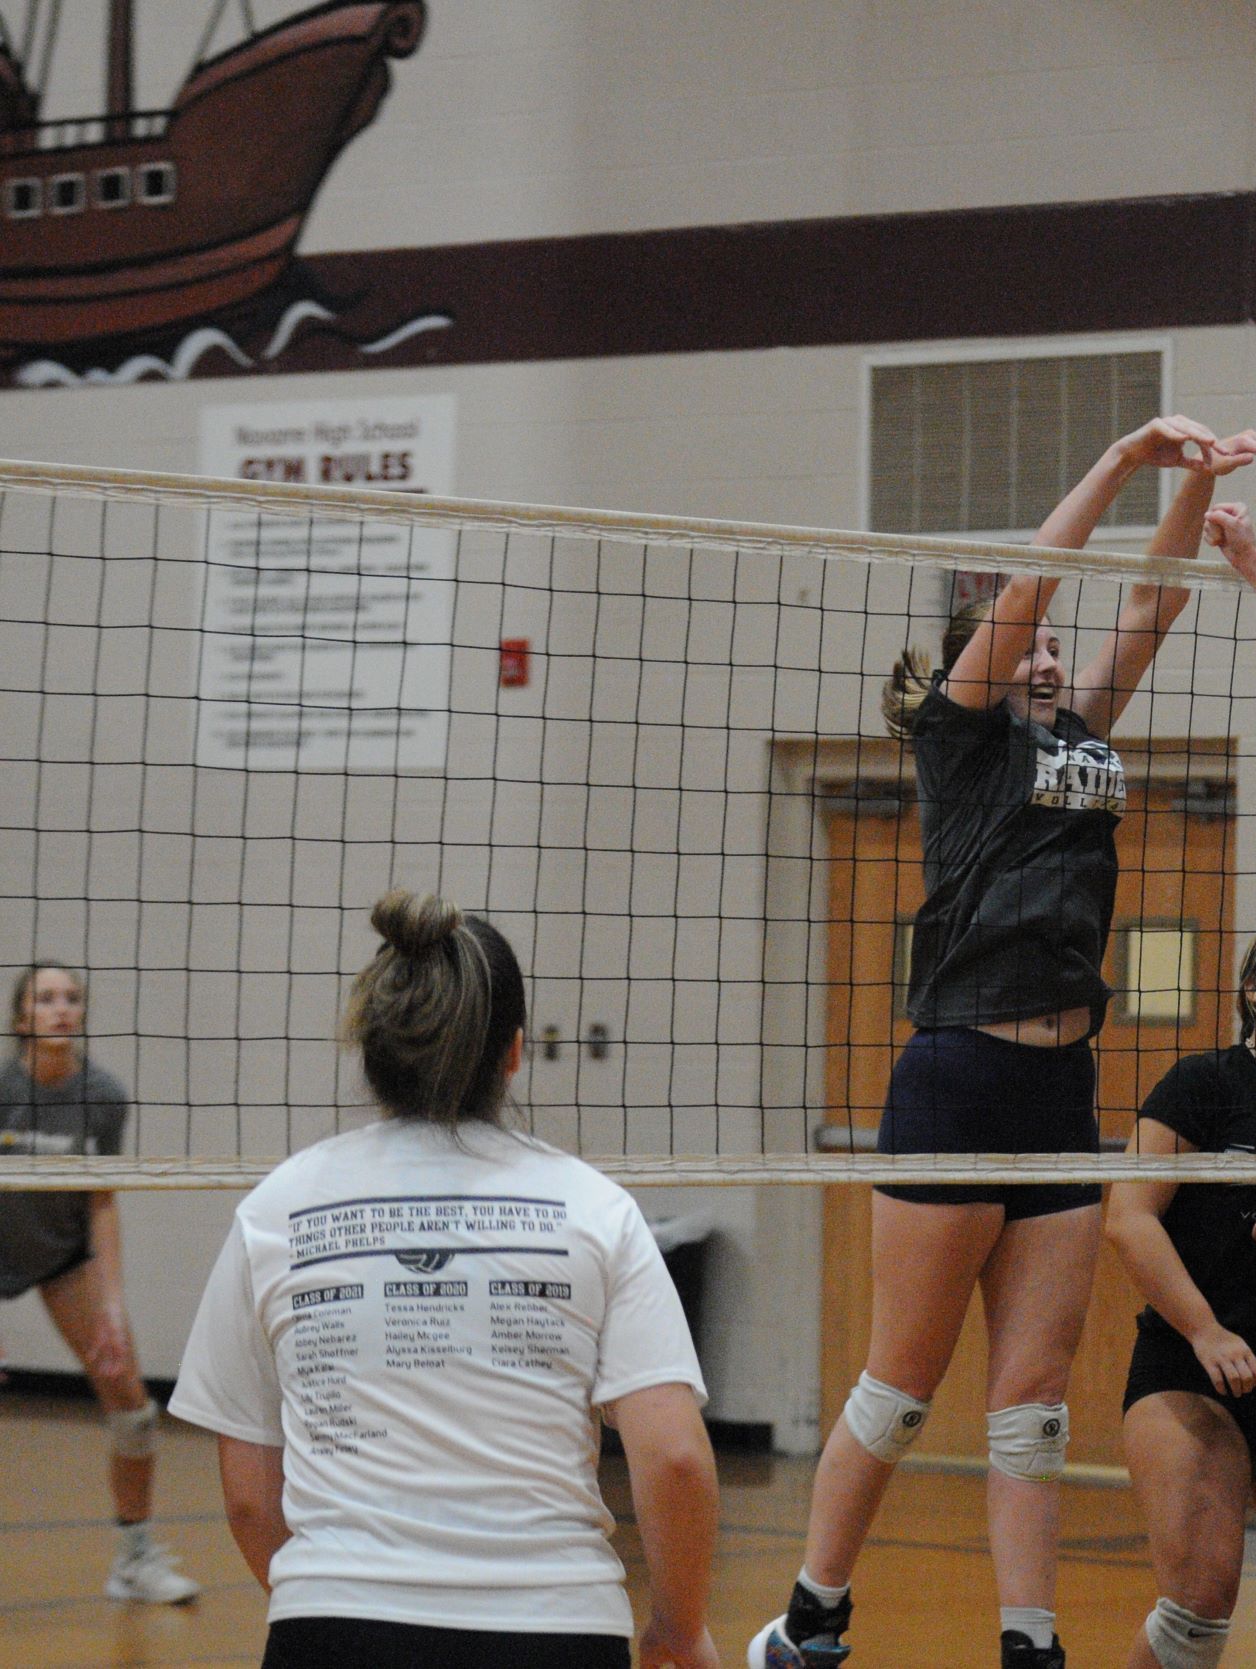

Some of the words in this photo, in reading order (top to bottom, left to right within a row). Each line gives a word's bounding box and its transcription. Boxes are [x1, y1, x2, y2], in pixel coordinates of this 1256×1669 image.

[321, 452, 413, 482] RULES
[306, 1215, 327, 1229] YOU
[331, 1209, 366, 1223] WANT
[371, 1208, 385, 1219] TO
[389, 1207, 403, 1218] BE
[408, 1206, 431, 1217] THE
[472, 1205, 494, 1217] YOU
[499, 1206, 530, 1218] HAVE
[535, 1208, 549, 1219] TO
[553, 1209, 567, 1220] DO
[289, 1229, 326, 1248] THINGS
[330, 1223, 367, 1238] OTHER
[371, 1221, 415, 1234] PEOPLE
[465, 1220, 516, 1232] WILLING
[520, 1221, 535, 1232] TO
[296, 1240, 340, 1259] MICHAEL
[345, 1236, 386, 1250] PHELPS
[385, 1282, 419, 1297] CLASS
[422, 1283, 437, 1296] OF
[490, 1282, 525, 1297] CLASS
[528, 1283, 542, 1297] OF
[293, 1291, 321, 1309] CLASS
[324, 1289, 336, 1302] OF
[385, 1303, 414, 1313] Tessa
[416, 1303, 465, 1313] Hendricks
[385, 1317, 428, 1327] Veronica
[490, 1316, 524, 1328] Megan
[386, 1359, 412, 1370] Mary
